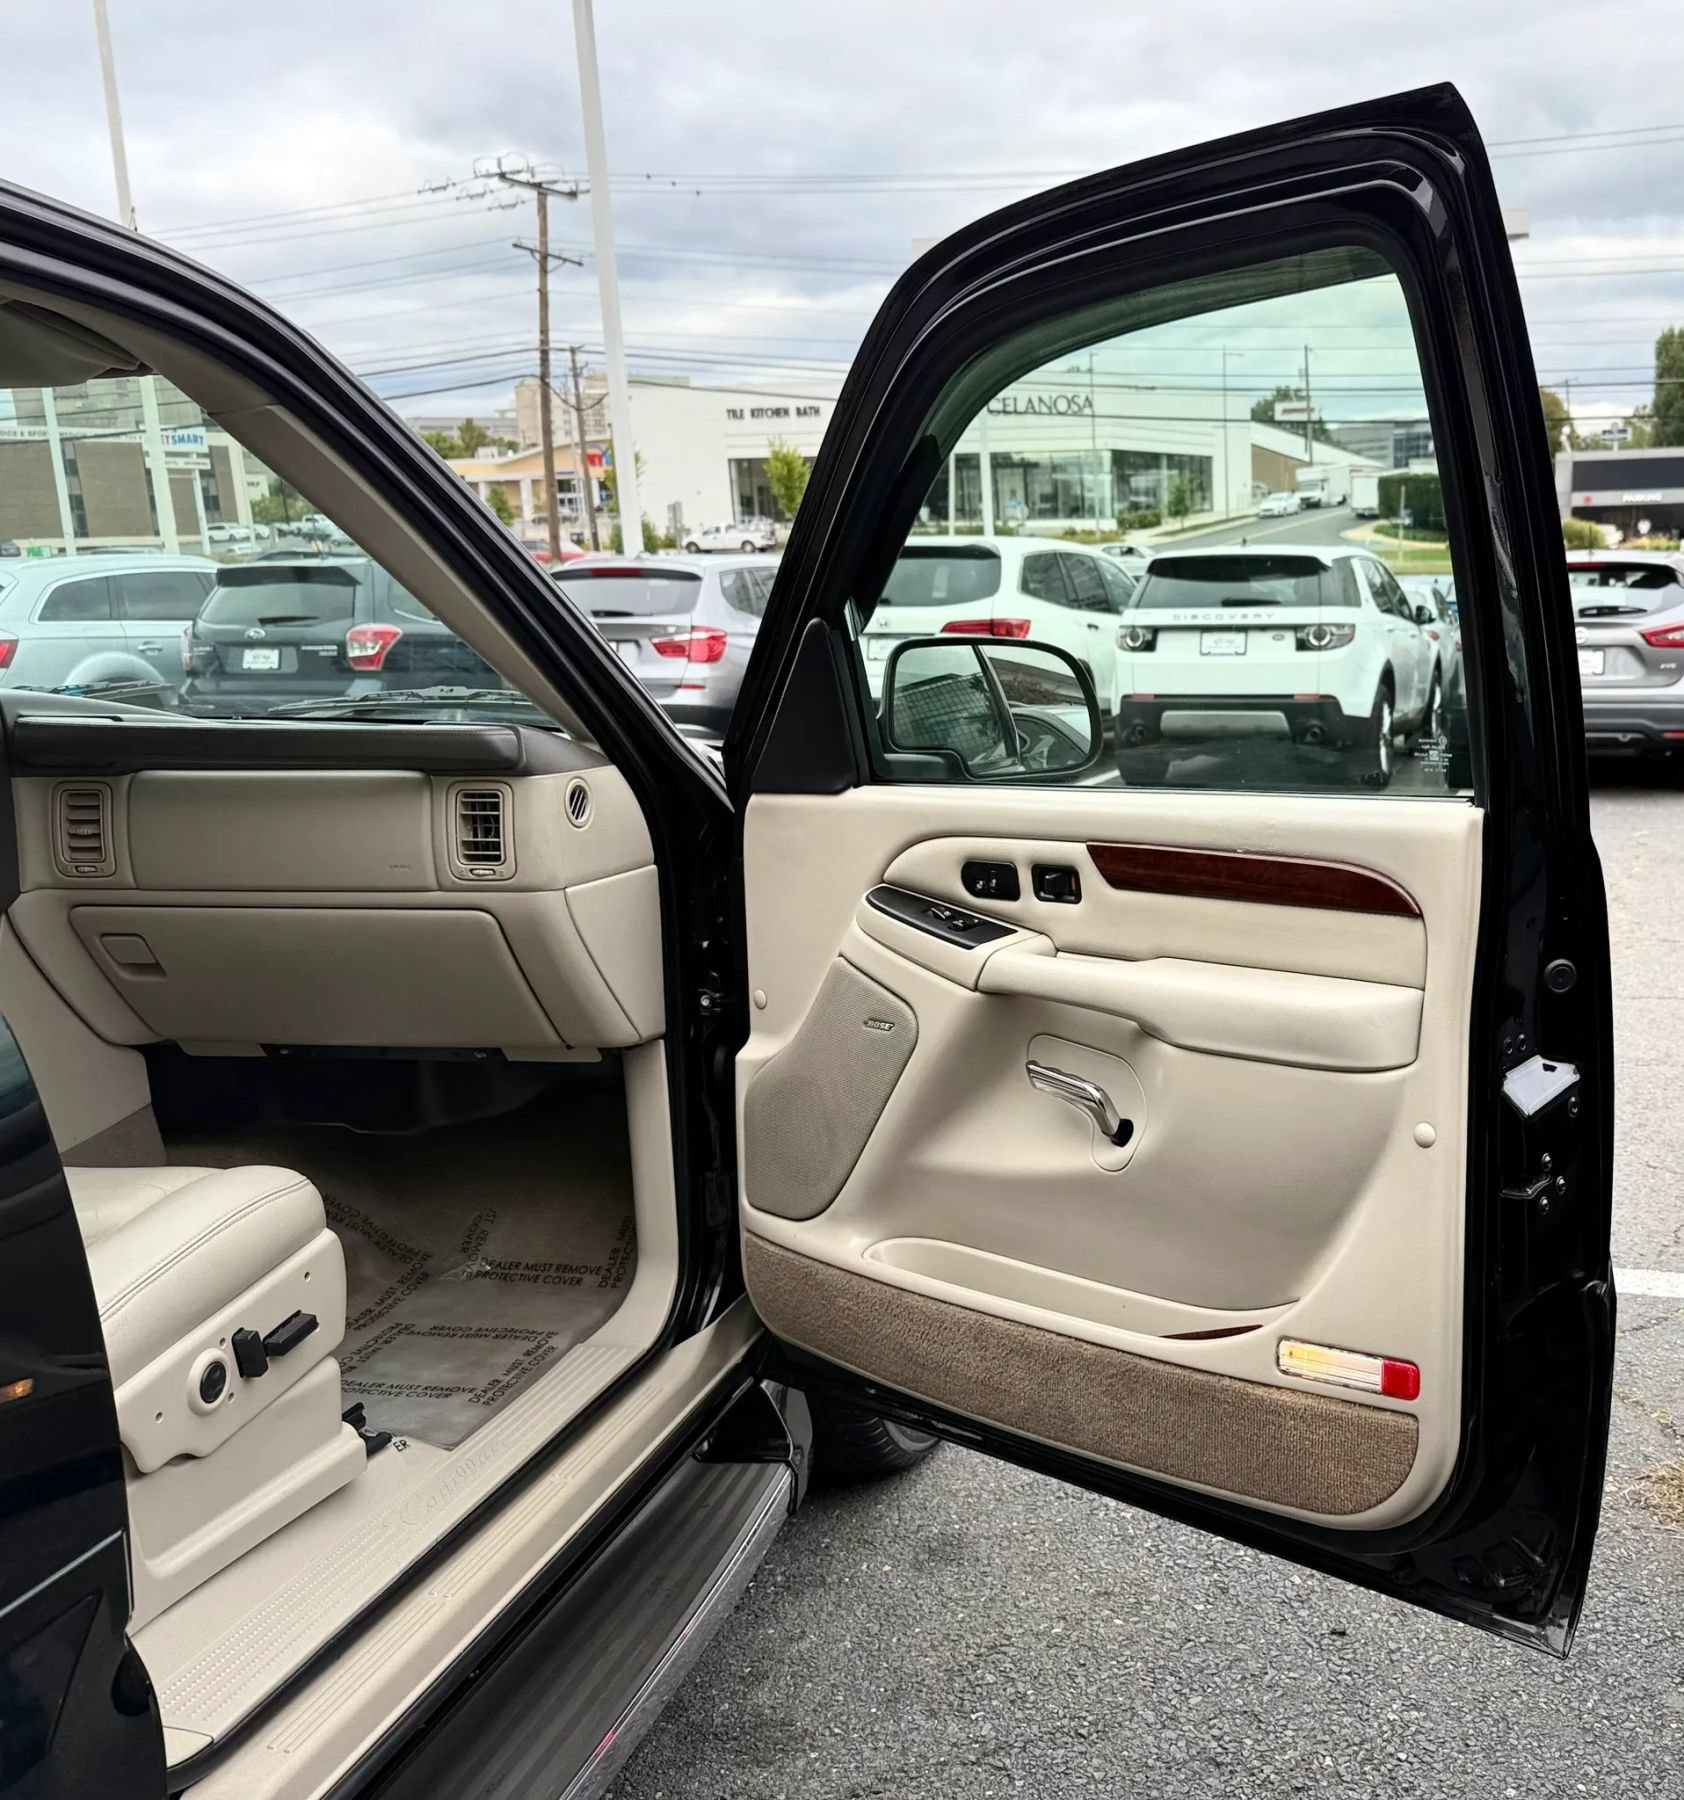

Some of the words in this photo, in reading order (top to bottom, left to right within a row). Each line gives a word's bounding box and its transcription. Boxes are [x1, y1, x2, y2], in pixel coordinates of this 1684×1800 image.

[726, 408, 745, 420] TILE
[750, 407, 790, 419] KITCHEN
[795, 406, 821, 417] BATH
[987, 394, 1093, 416] CELANOSA
[1172, 612, 1275, 621] DISCOVERY
[480, 1257, 521, 1271] DEALER
[524, 1261, 552, 1273] MUST
[555, 1263, 603, 1276] REMOVE
[598, 1247, 621, 1289] DEALER
[474, 1271, 540, 1285] PROTECTIVE
[542, 1275, 583, 1287] COVER
[468, 1378, 502, 1404] DEALER
[503, 1358, 524, 1378] MUST
[482, 1365, 533, 1407] PROTECTIVE
[528, 1345, 559, 1368] COVER
[389, 1383, 422, 1392] MUST
[422, 1385, 478, 1395] REMOVE
[405, 1391, 453, 1400] COVER
[392, 1438, 411, 1453] ER
